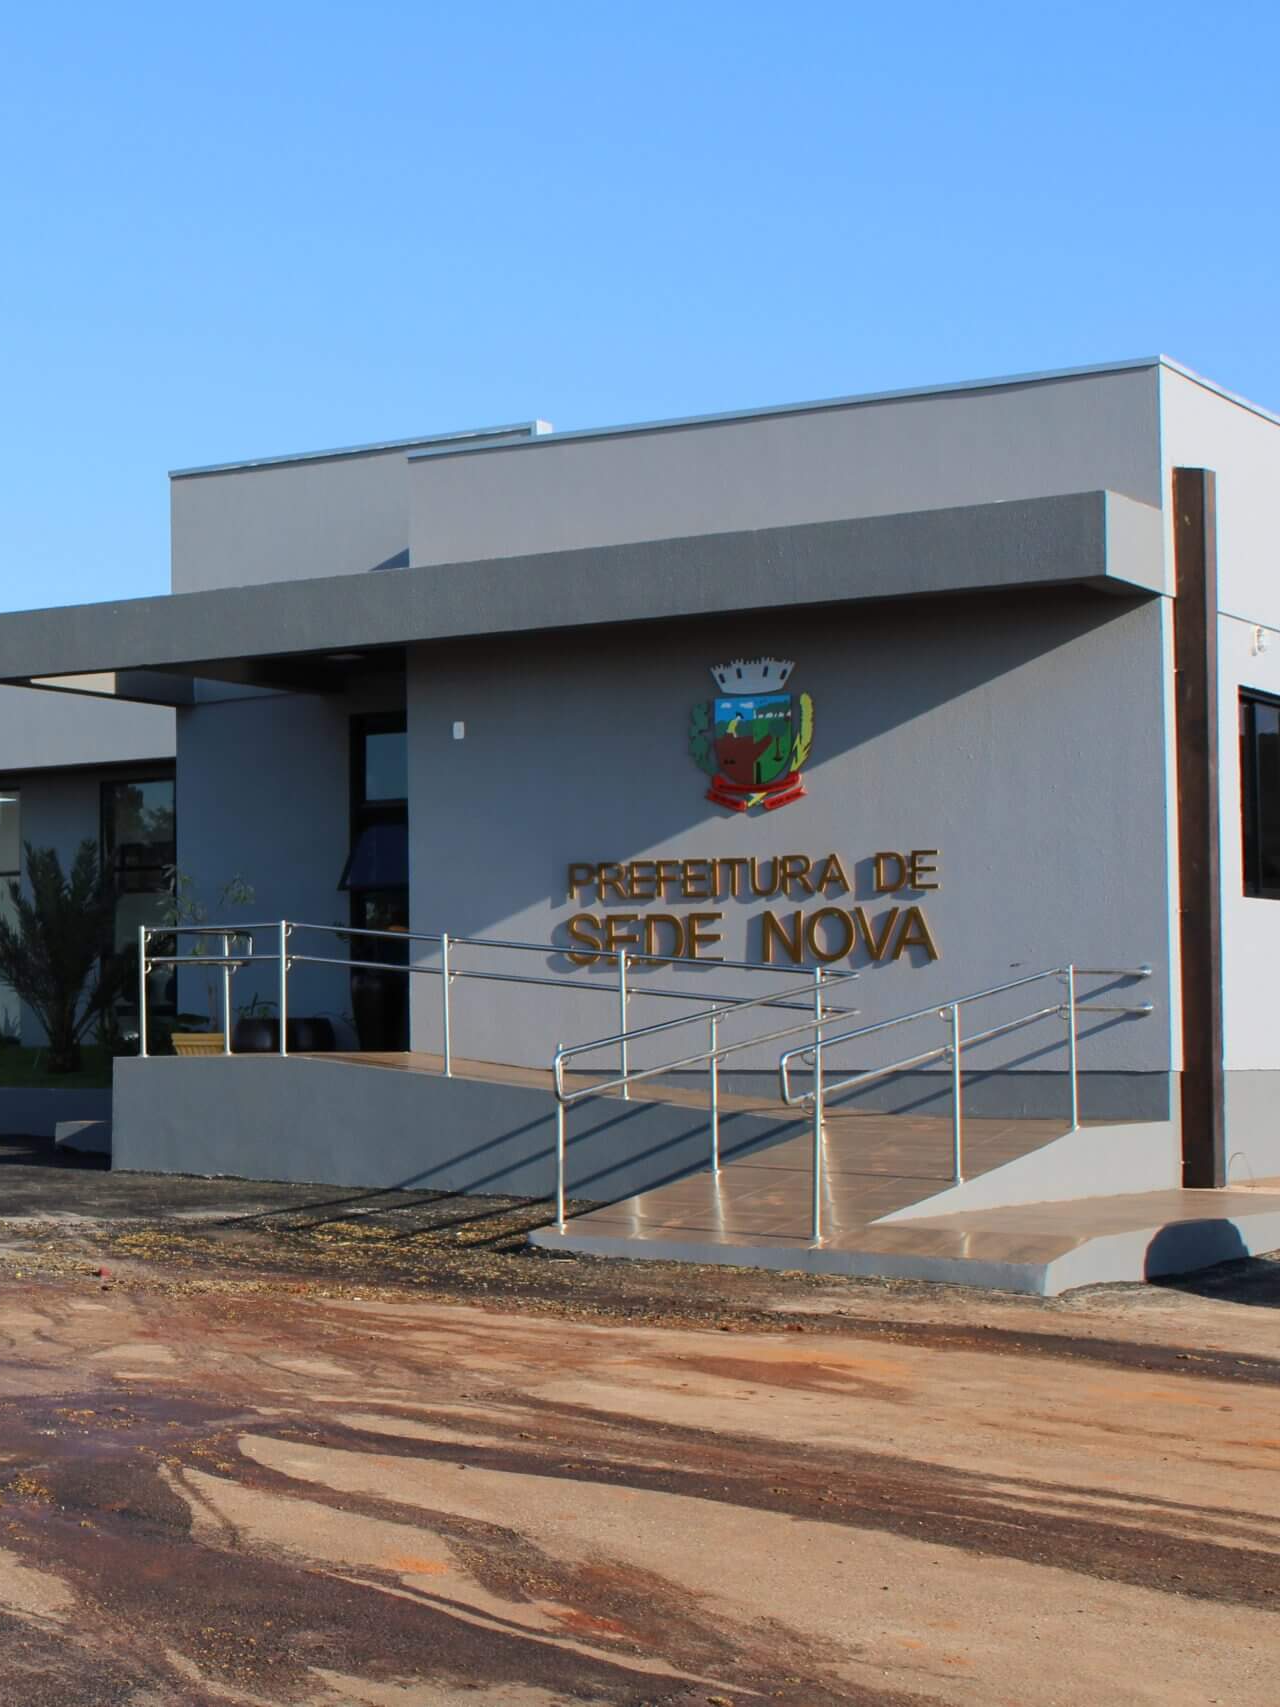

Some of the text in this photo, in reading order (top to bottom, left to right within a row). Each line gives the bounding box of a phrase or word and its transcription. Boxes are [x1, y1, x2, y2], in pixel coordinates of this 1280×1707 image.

[567, 850, 940, 902] PREFEITURA DE
[567, 906, 939, 966] SEDE NOVA
